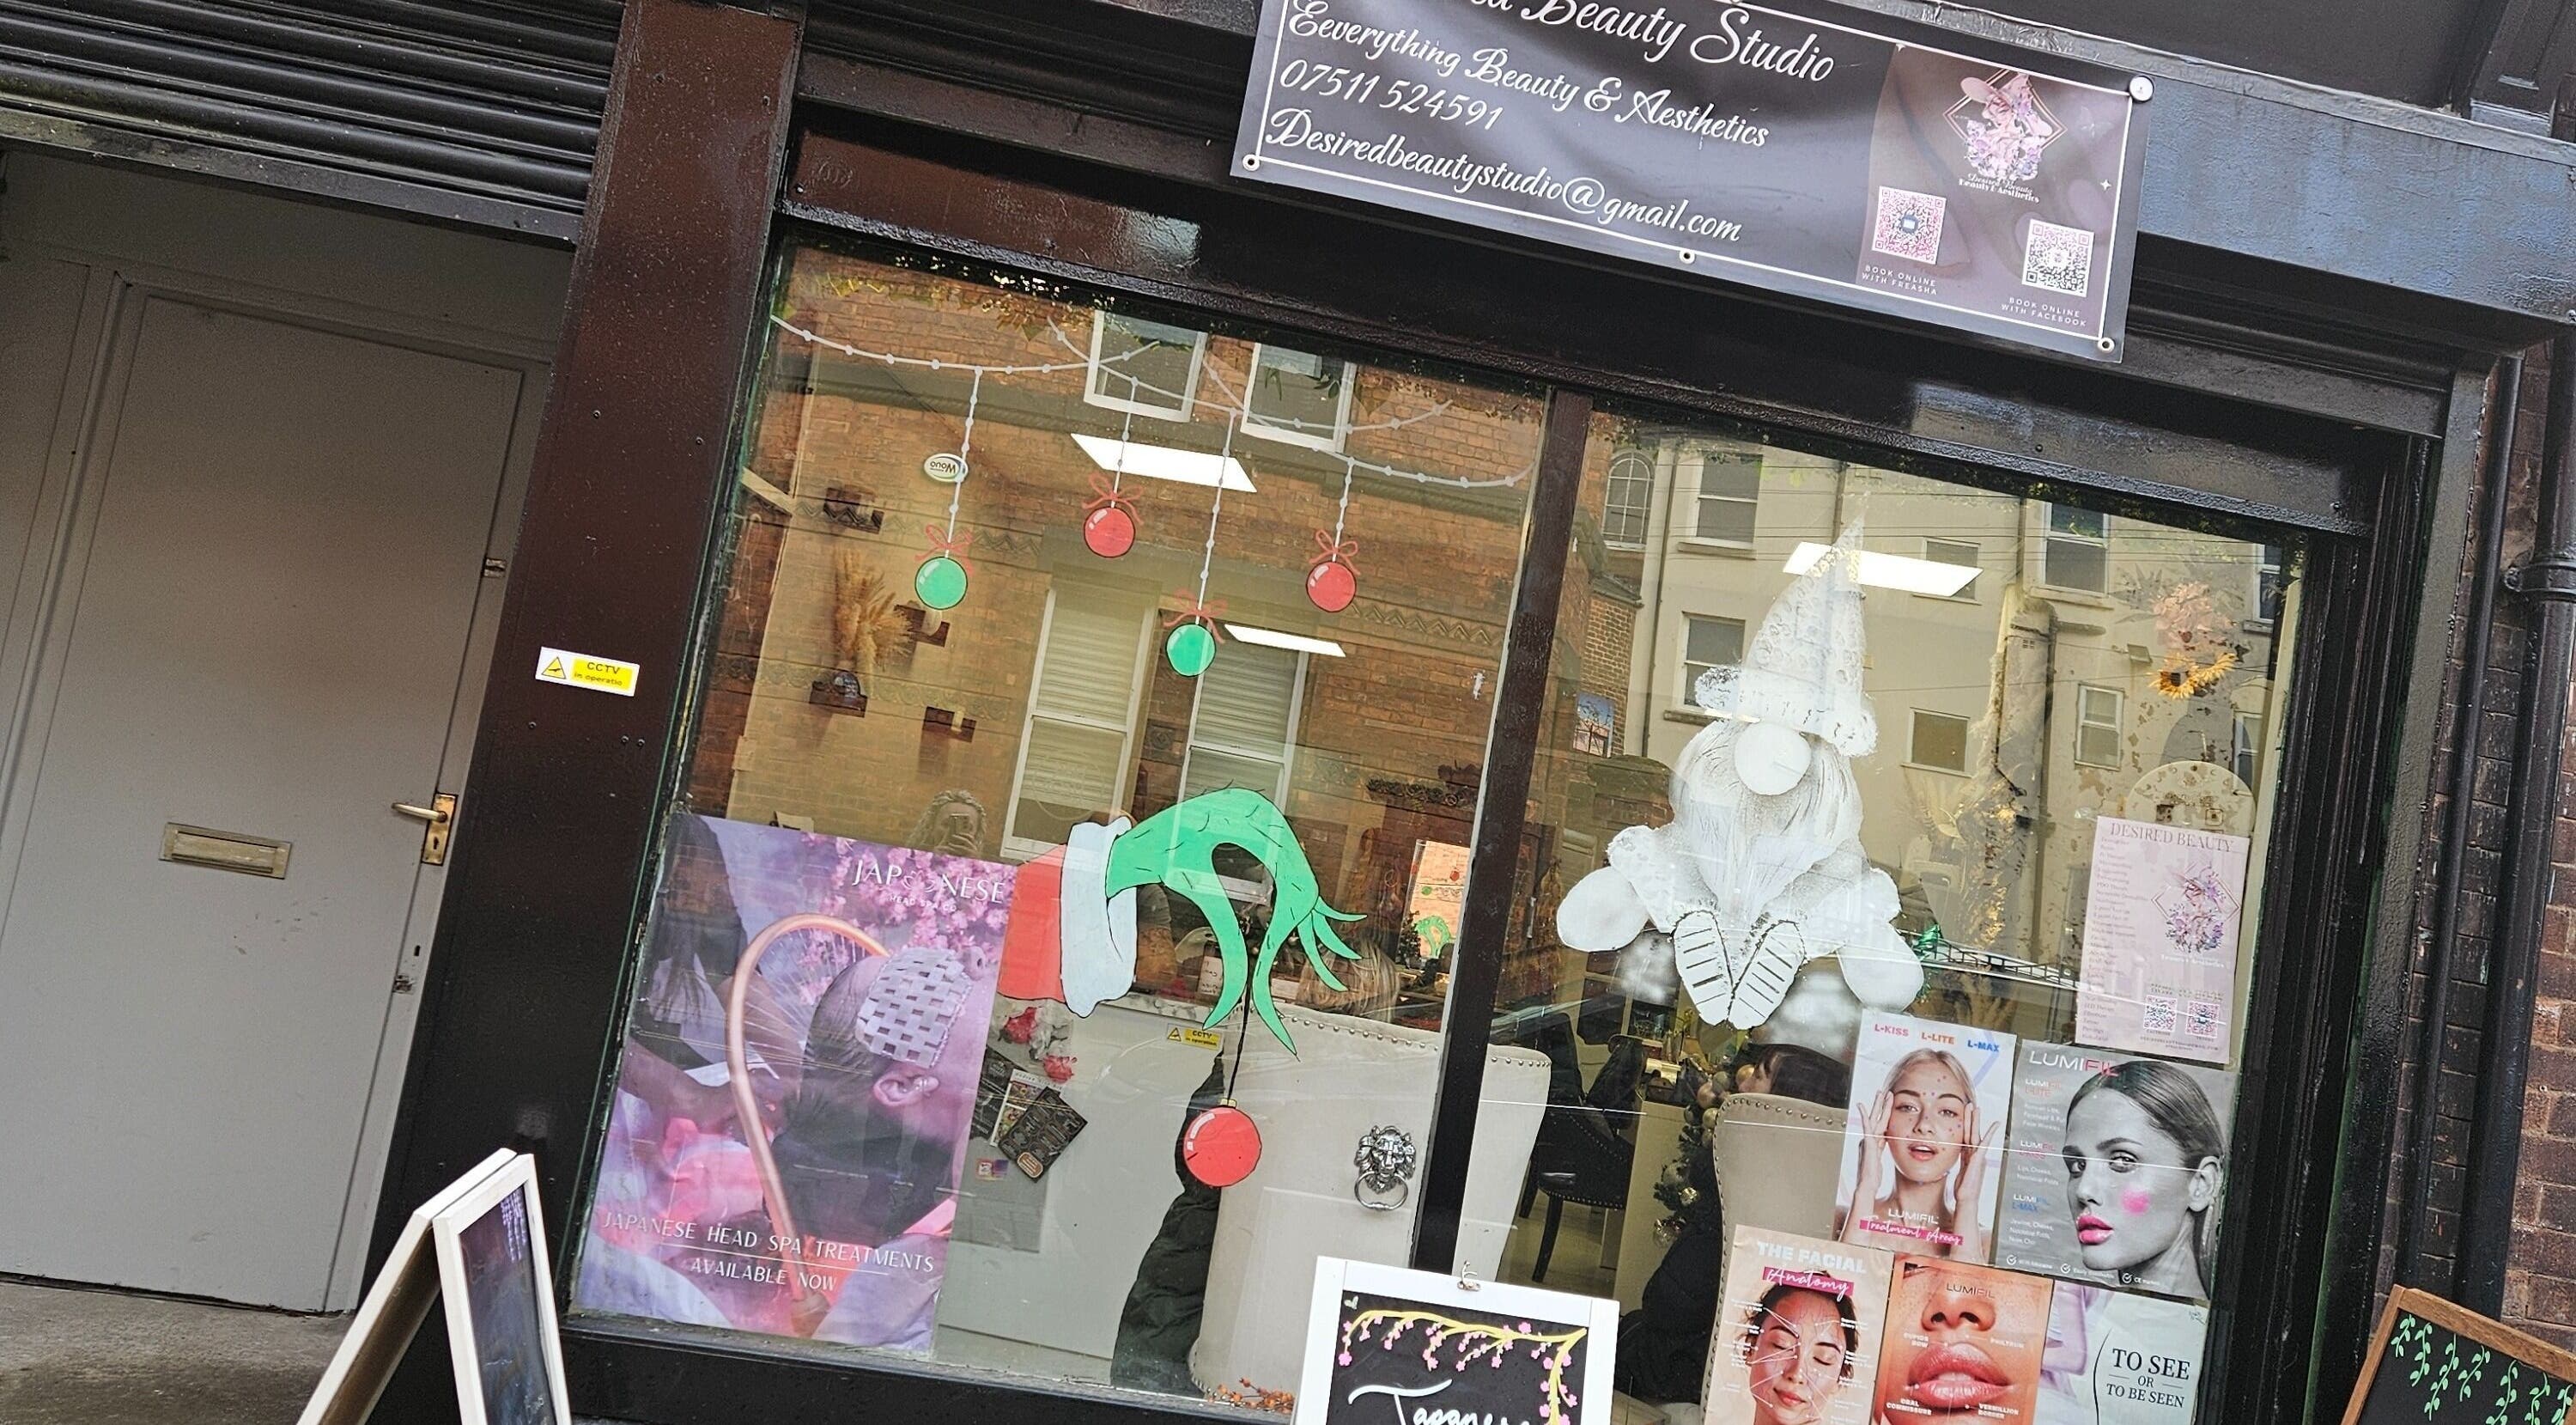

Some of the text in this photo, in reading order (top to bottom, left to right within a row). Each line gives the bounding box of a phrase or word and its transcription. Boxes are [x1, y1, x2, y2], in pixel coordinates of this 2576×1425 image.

[1690, 8, 1834, 81] Studio
[1289, 0, 1770, 147] Eeverything Beauty & Aesthetics
[1279, 59, 1504, 130] 07511 524591
[1265, 107, 1742, 241] Desiredbeautystudio@gmail.com
[1862, 272, 1887, 285] WITH
[1865, 265, 1936, 287] BOOK ONLINE
[2001, 303, 2087, 327] WITH FACEBOOK
[2008, 297, 2080, 317] BOOK ONLINE
[586, 661, 620, 674] CCTV
[2110, 822, 2234, 852] DESIRED BEAUTY
[890, 895, 915, 906] HEAD
[920, 899, 938, 910] SPA
[1874, 1024, 2000, 1052] L-KISS L-LITE L-MAX
[2029, 1050, 2120, 1077] LUMIFIL
[1866, 1215, 1923, 1238] Treatment
[1888, 1208, 1939, 1225] LUMIFIL
[604, 1212, 934, 1272] JAPANESE HEAD SPA TREATMENTS
[1758, 1241, 1867, 1274] THE FACIAL
[690, 1258, 837, 1291] AVAILABLE NOW
[1767, 1268, 1849, 1302] Anatomy
[1946, 1282, 1996, 1299] LUMIFIL
[2112, 1348, 2190, 1380] TO SEE
[2137, 1375, 2154, 1388] OR
[2106, 1383, 2184, 1408] TO BE SEEN
